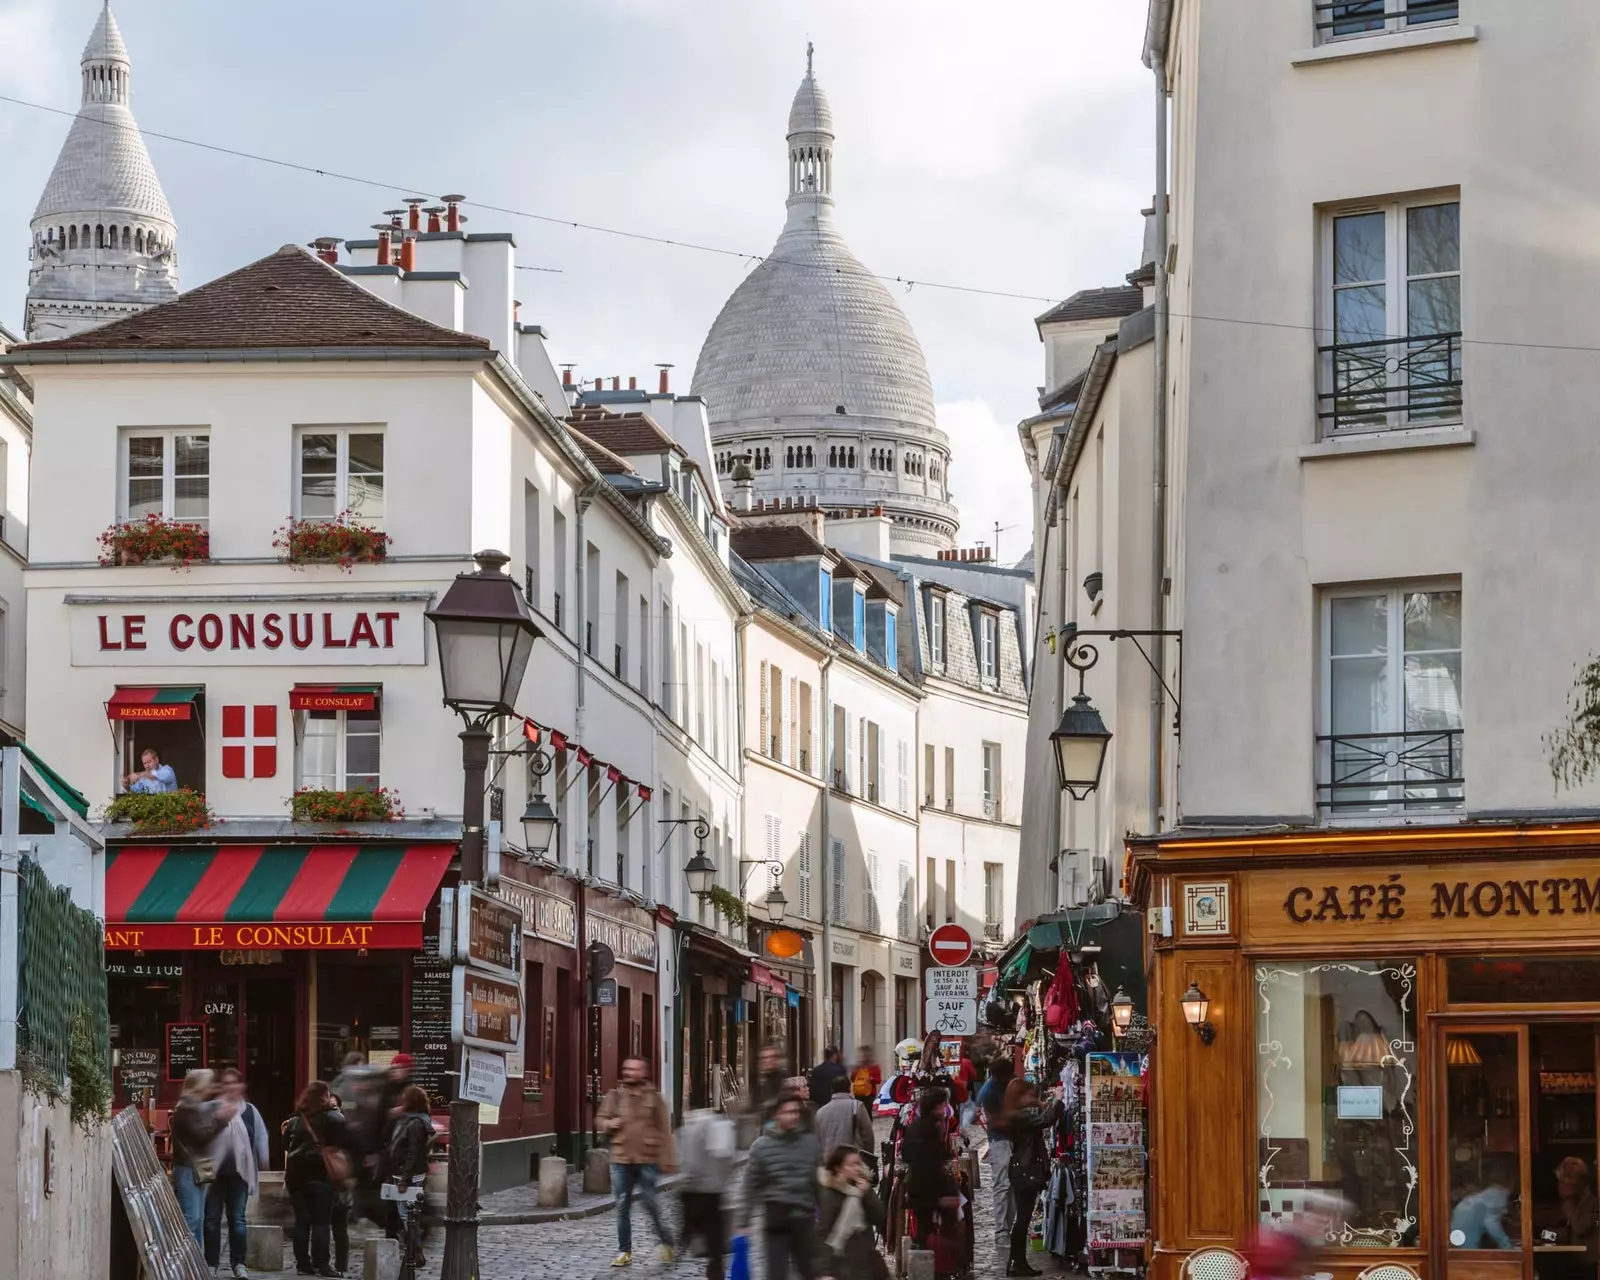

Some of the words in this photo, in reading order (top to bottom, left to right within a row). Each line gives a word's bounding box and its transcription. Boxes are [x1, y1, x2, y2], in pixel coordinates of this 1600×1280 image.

[98, 615, 147, 651] LE
[168, 612, 400, 651] CONSULAT
[120, 707, 178, 717] RESTAURANT
[299, 697, 312, 706] LE
[315, 697, 364, 707] CONSULAT
[1284, 874, 1406, 923] CAFÉ
[540, 901, 548, 929] DE
[193, 927, 224, 946] LE
[236, 926, 373, 946] CONSULAT
[938, 1002, 965, 1011] SAUF
